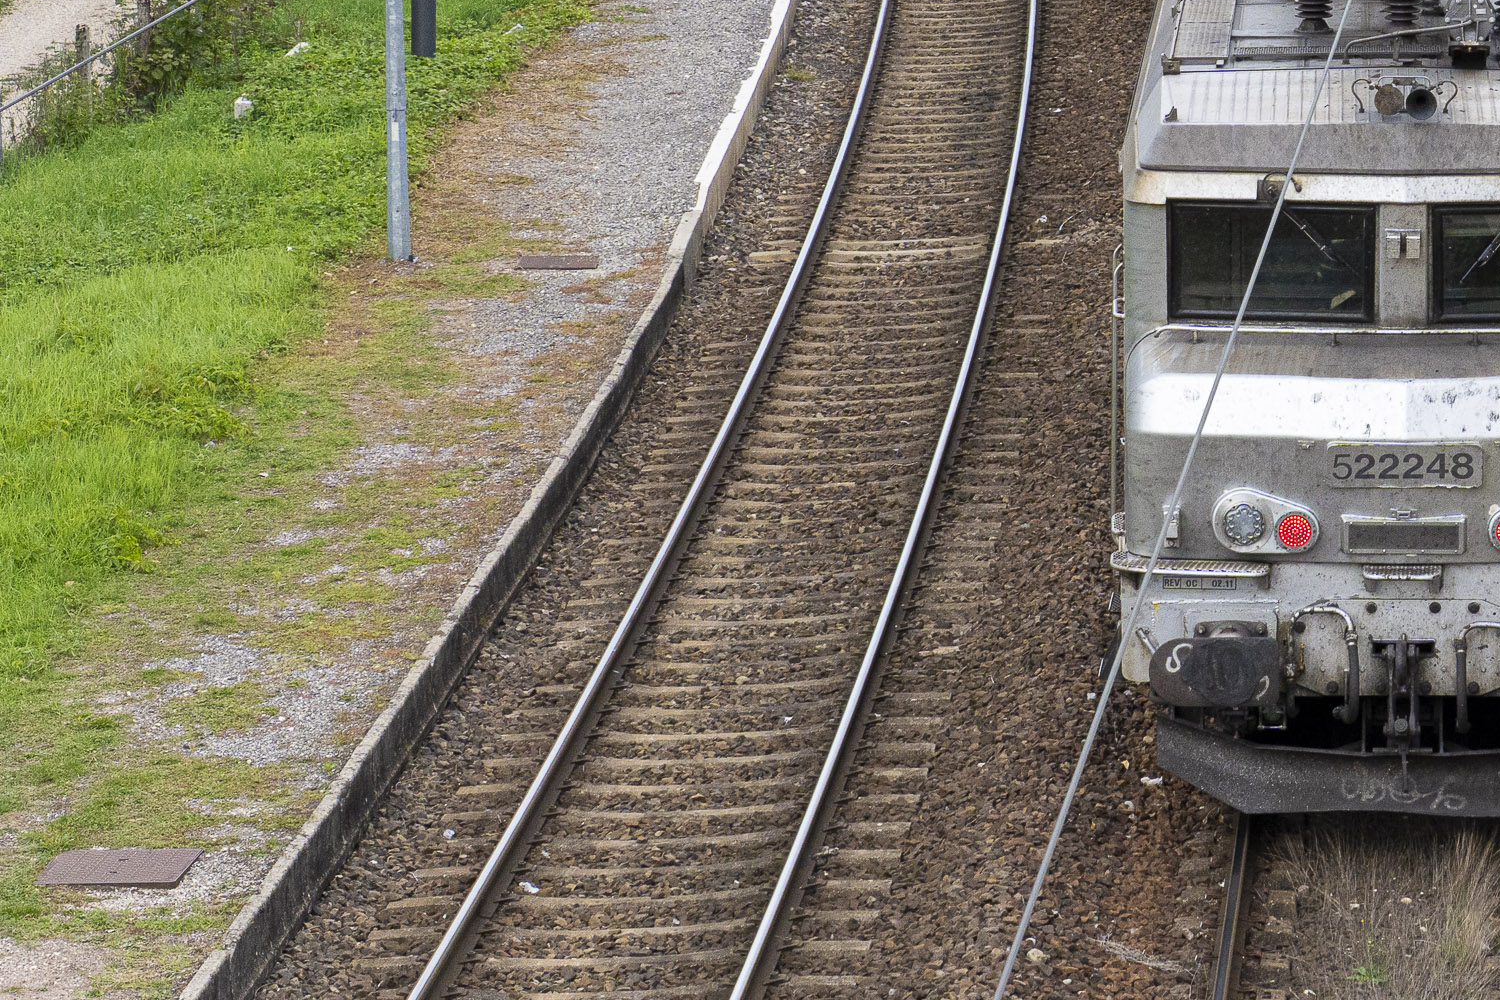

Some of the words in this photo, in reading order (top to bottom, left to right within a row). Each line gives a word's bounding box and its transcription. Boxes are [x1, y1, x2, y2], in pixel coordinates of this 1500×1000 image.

[1332, 453, 1474, 480] 522248
[1164, 578, 1180, 587] REV
[1211, 579, 1233, 588] 02.11
